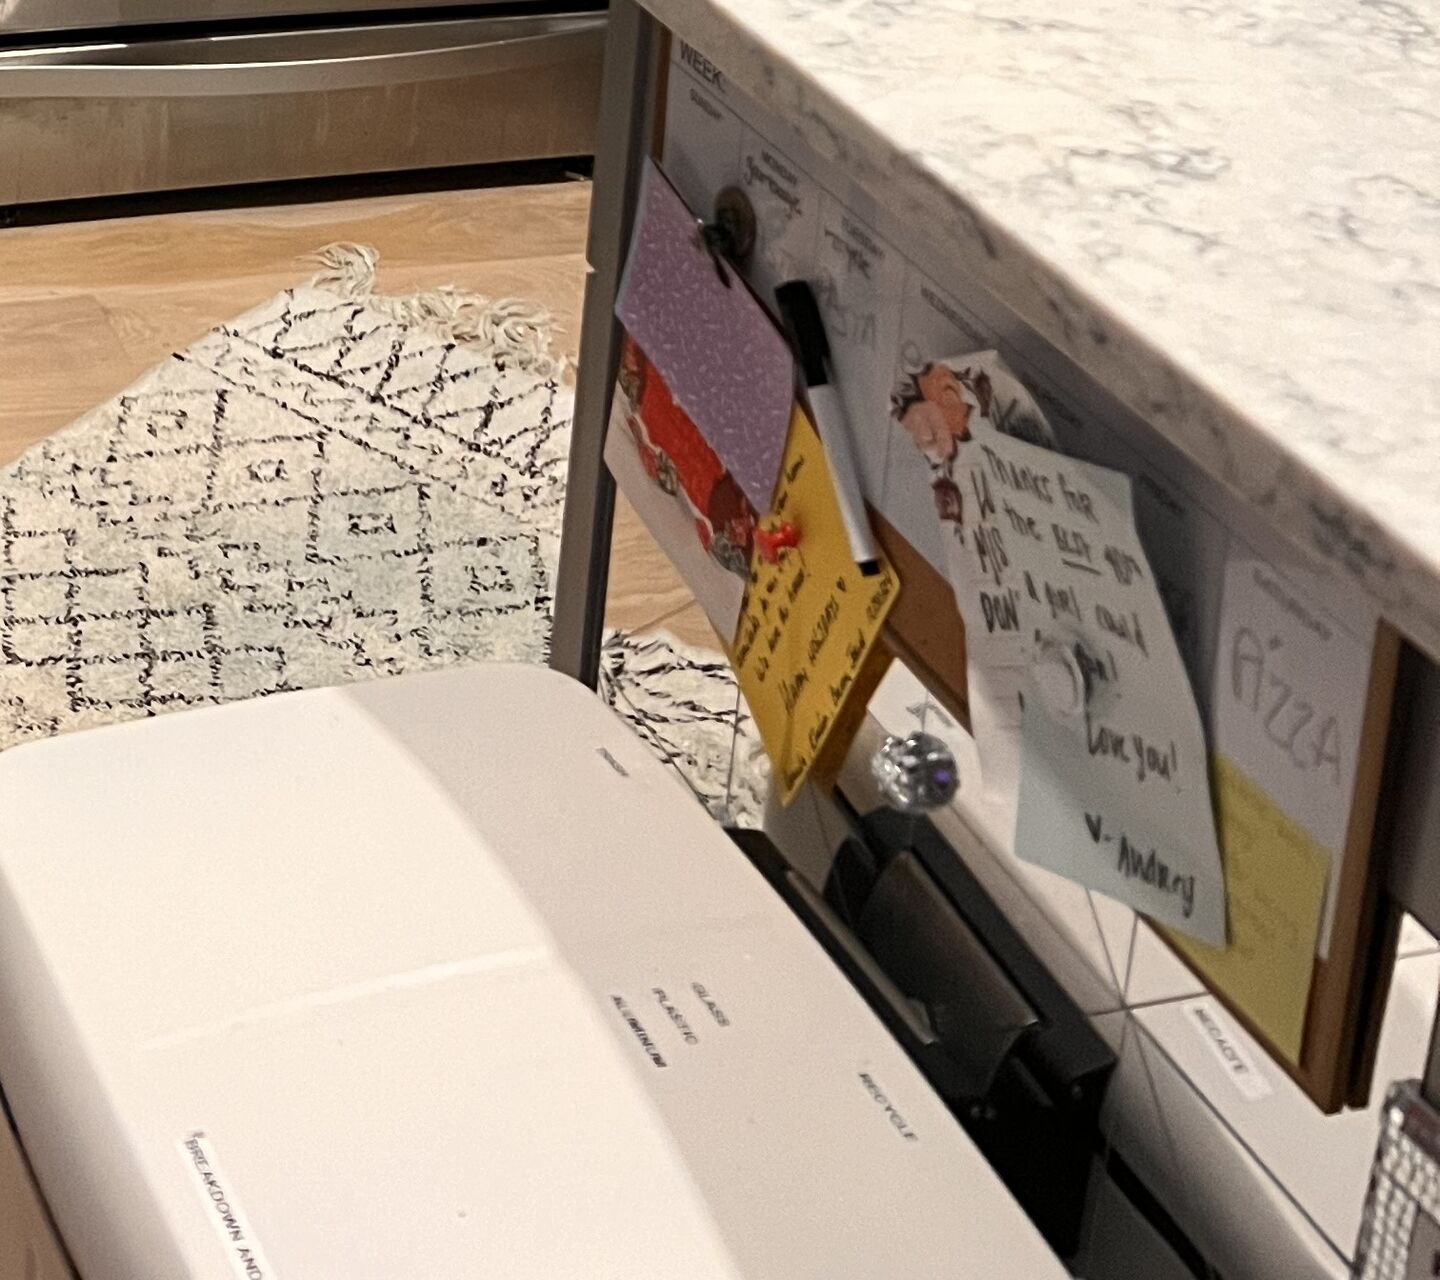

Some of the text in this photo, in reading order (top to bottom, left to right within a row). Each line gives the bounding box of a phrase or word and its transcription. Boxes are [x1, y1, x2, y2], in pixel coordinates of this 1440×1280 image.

[612, 995, 668, 1068] ALUMINUM
[652, 987, 699, 1046] PLASTIC
[858, 1072, 919, 1141] RECYCLE
[184, 1138, 246, 1242] BREAKDOWN
